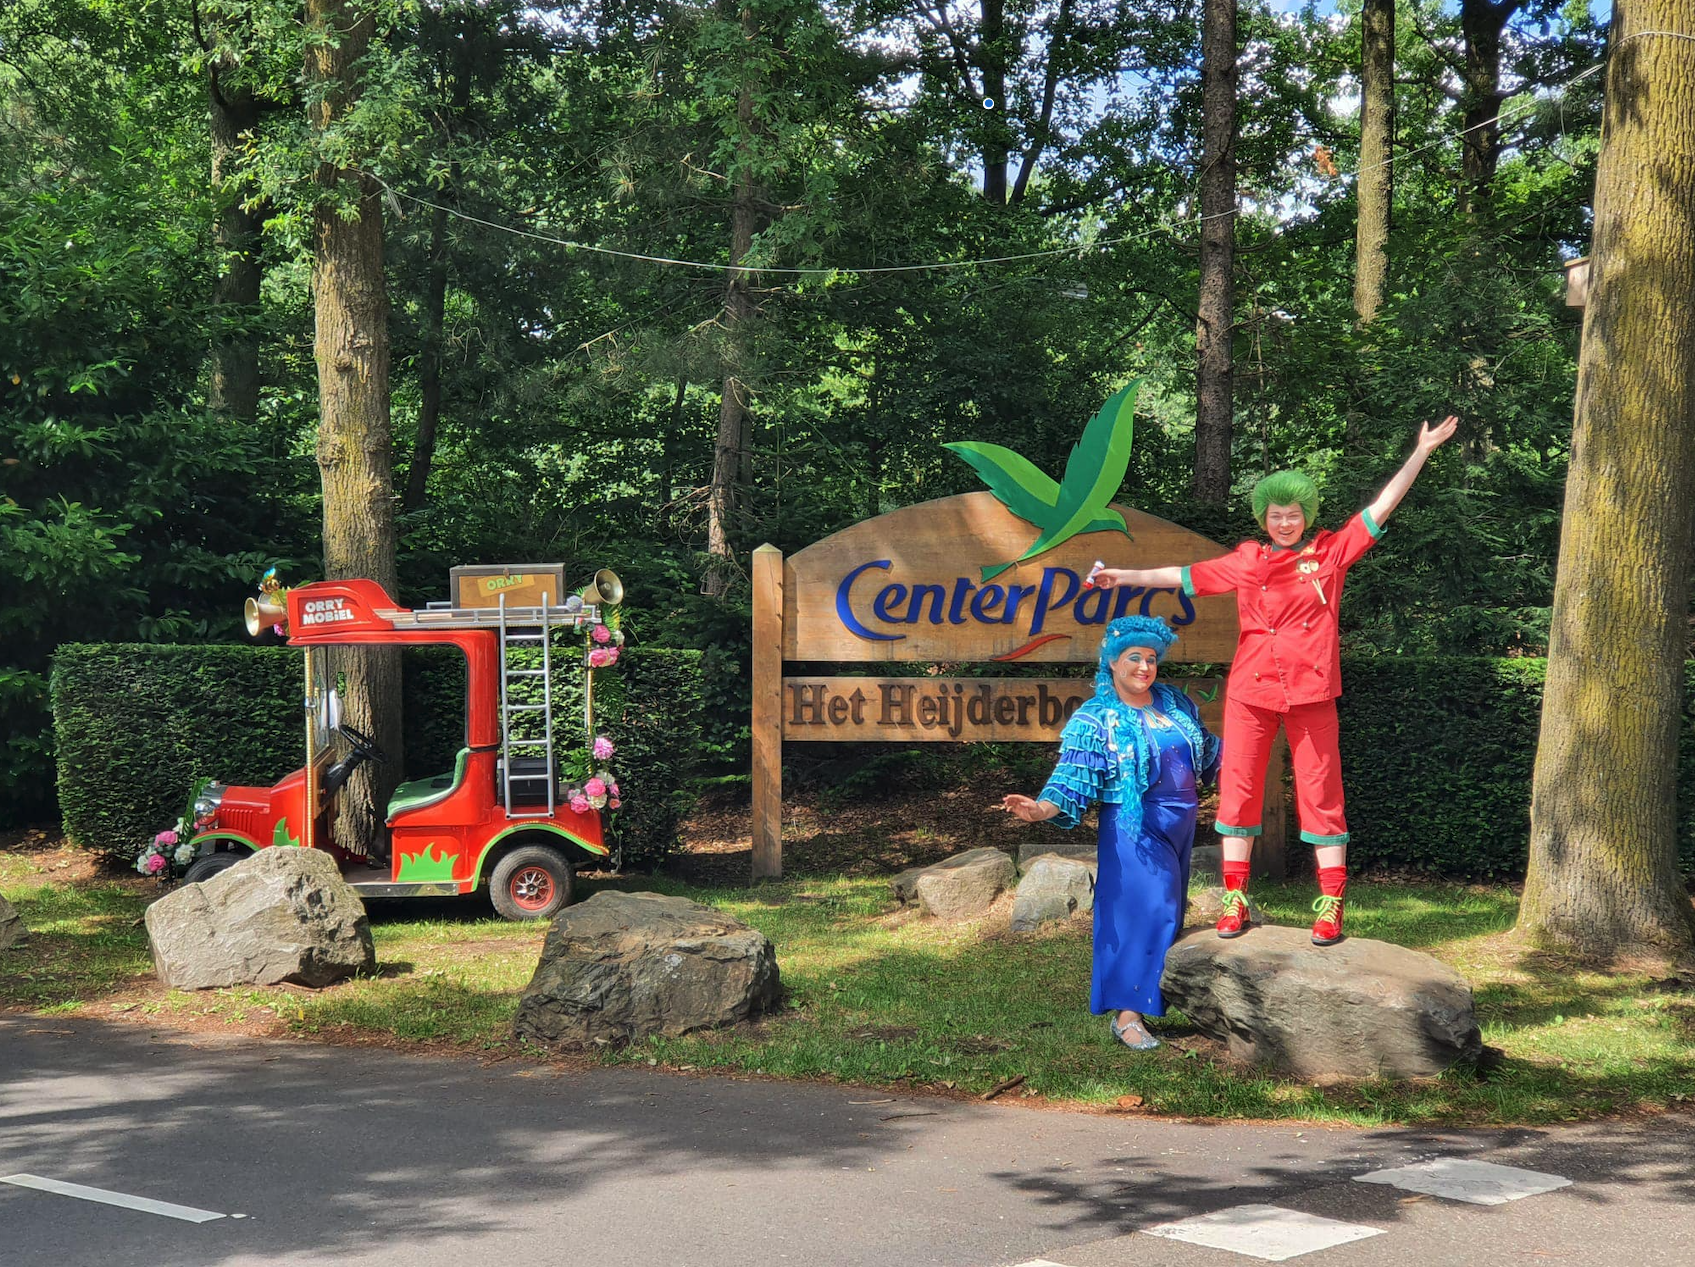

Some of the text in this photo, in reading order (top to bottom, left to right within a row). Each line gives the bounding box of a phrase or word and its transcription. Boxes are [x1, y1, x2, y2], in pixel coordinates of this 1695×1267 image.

[305, 598, 344, 613] ORRY
[788, 682, 1094, 737] Het Heijderbo
